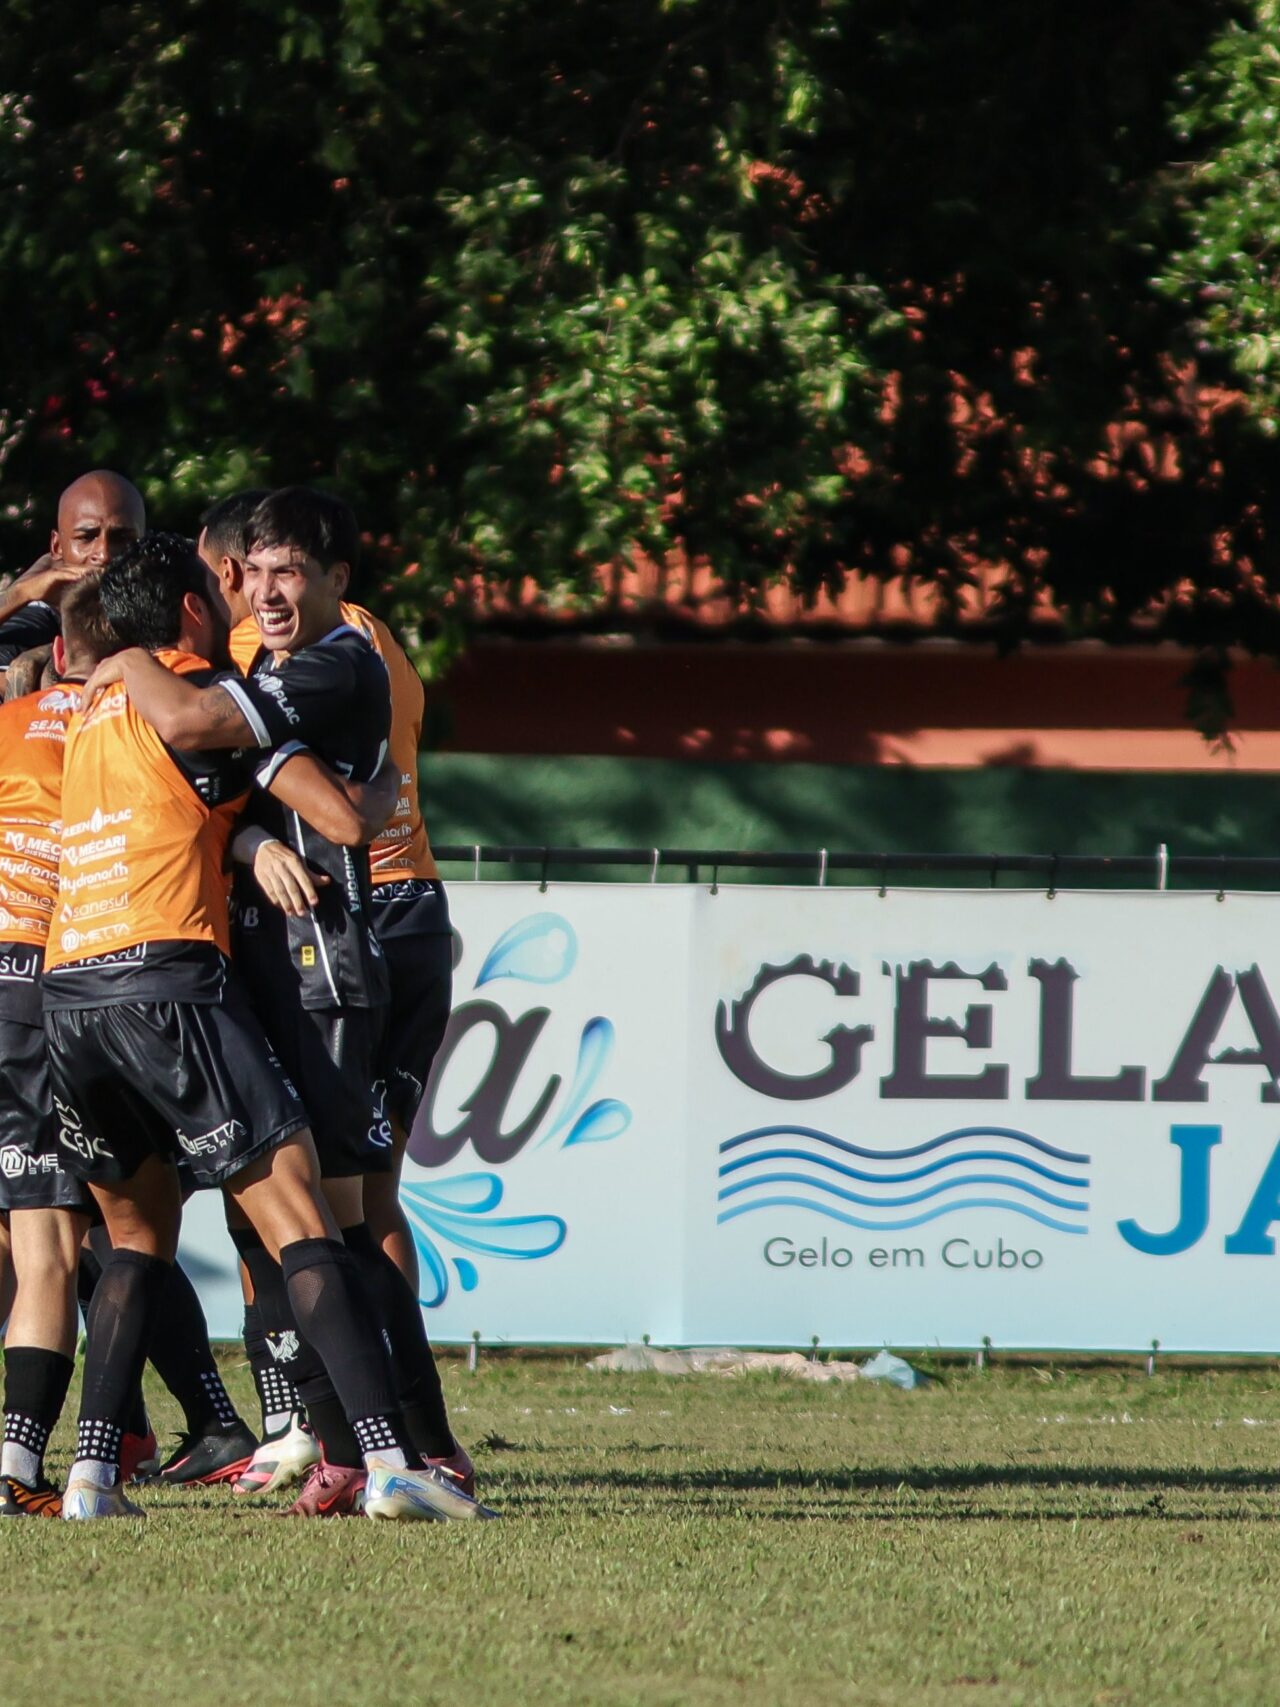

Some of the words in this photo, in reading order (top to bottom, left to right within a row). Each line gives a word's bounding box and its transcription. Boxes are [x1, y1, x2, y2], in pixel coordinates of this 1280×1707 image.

[271, 689, 300, 725] PLAC
[28, 719, 65, 732] SEJA
[401, 773, 412, 785] AC
[395, 797, 410, 811] ARI
[103, 807, 132, 826] PLAC
[376, 823, 412, 840] north
[27, 836, 61, 855] MÉC
[78, 833, 127, 858] MÉCARI
[58, 861, 129, 897] Hydronorth
[8, 890, 58, 908] sanes
[73, 891, 129, 918] sanesul
[9, 917, 50, 931] MET
[59, 1127, 114, 1160] CEIC
[763, 1236, 853, 1268] Gelo
[868, 1246, 926, 1268] em
[940, 1237, 1044, 1269] Cubo
